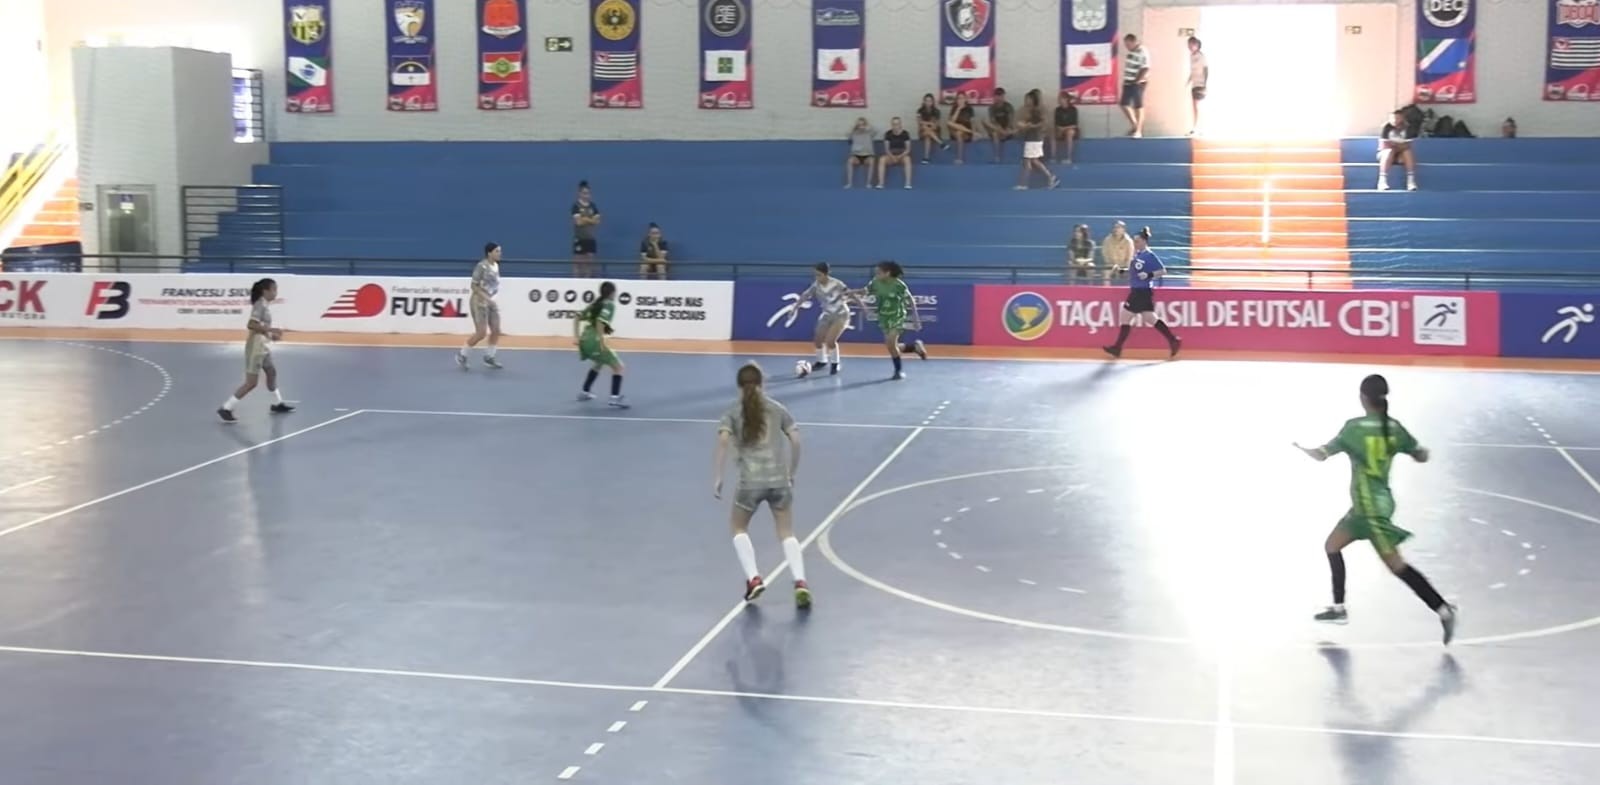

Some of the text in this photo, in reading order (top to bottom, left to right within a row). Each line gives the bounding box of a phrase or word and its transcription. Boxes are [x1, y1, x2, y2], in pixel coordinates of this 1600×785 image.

[391, 297, 468, 318] FUTSAL
[635, 309, 666, 319] REDES
[1056, 300, 1114, 334] TAÇA
[1207, 300, 1240, 327] DE
[1242, 300, 1332, 328] FUTSAL
